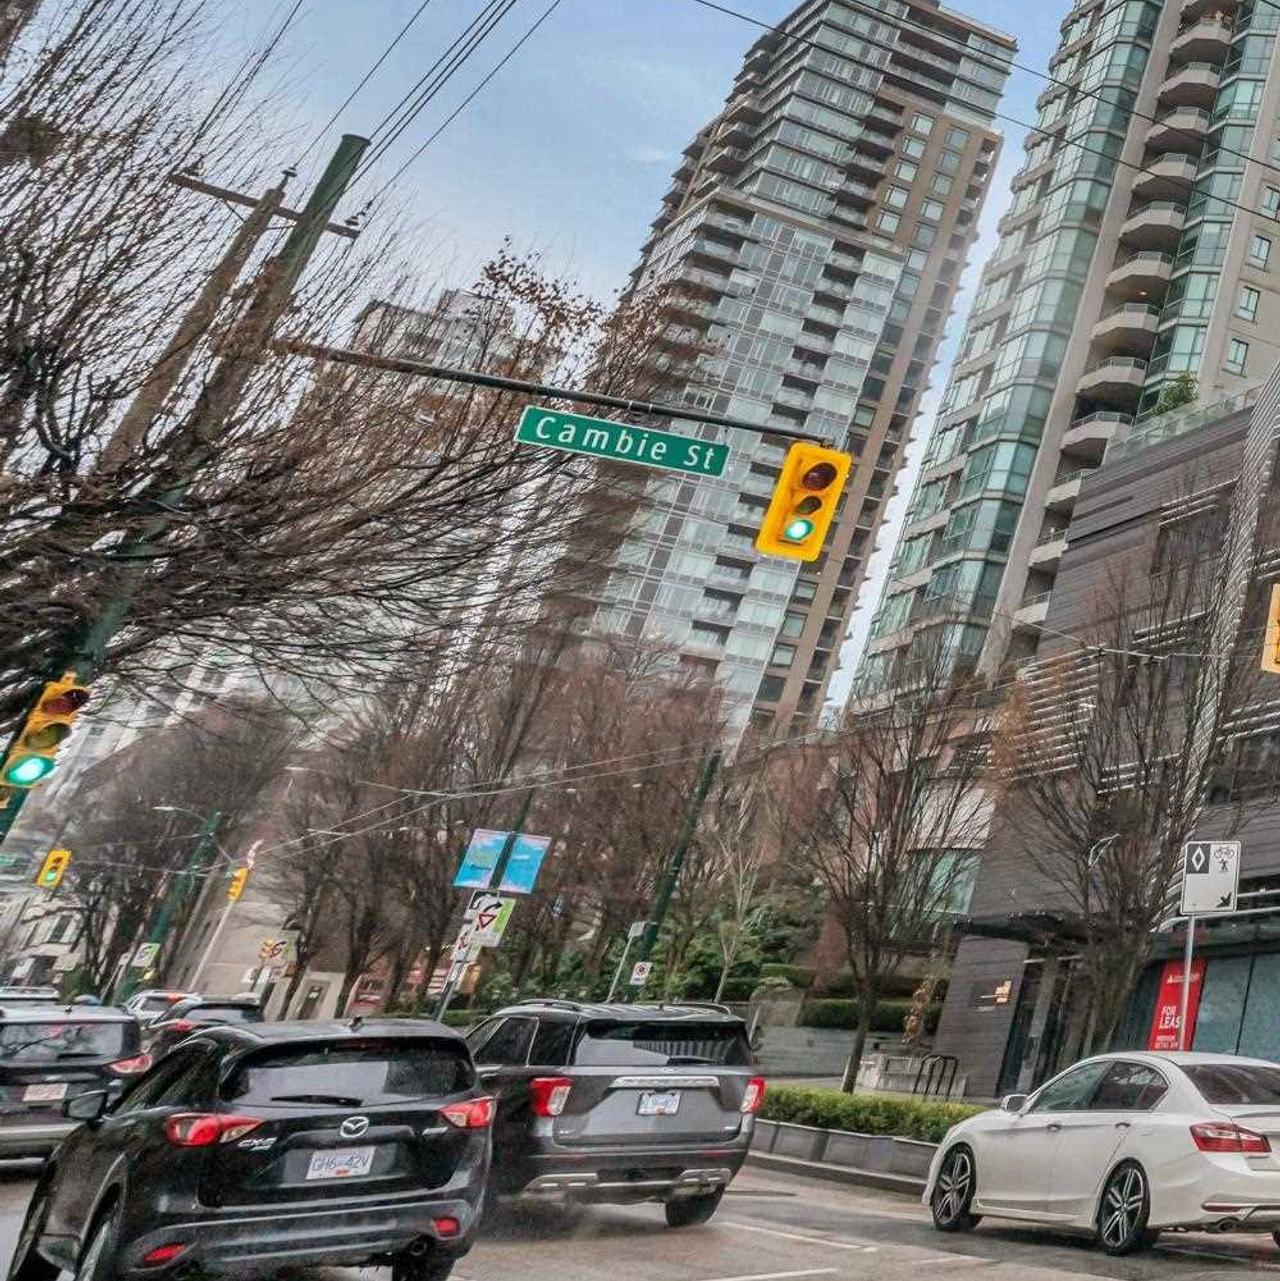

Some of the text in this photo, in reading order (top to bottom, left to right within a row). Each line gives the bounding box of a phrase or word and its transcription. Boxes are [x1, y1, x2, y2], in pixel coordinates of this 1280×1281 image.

[536, 416, 715, 470] Cambie St
[1161, 1005, 1177, 1017] FOR
[1159, 1016, 1181, 1030] LEAS
